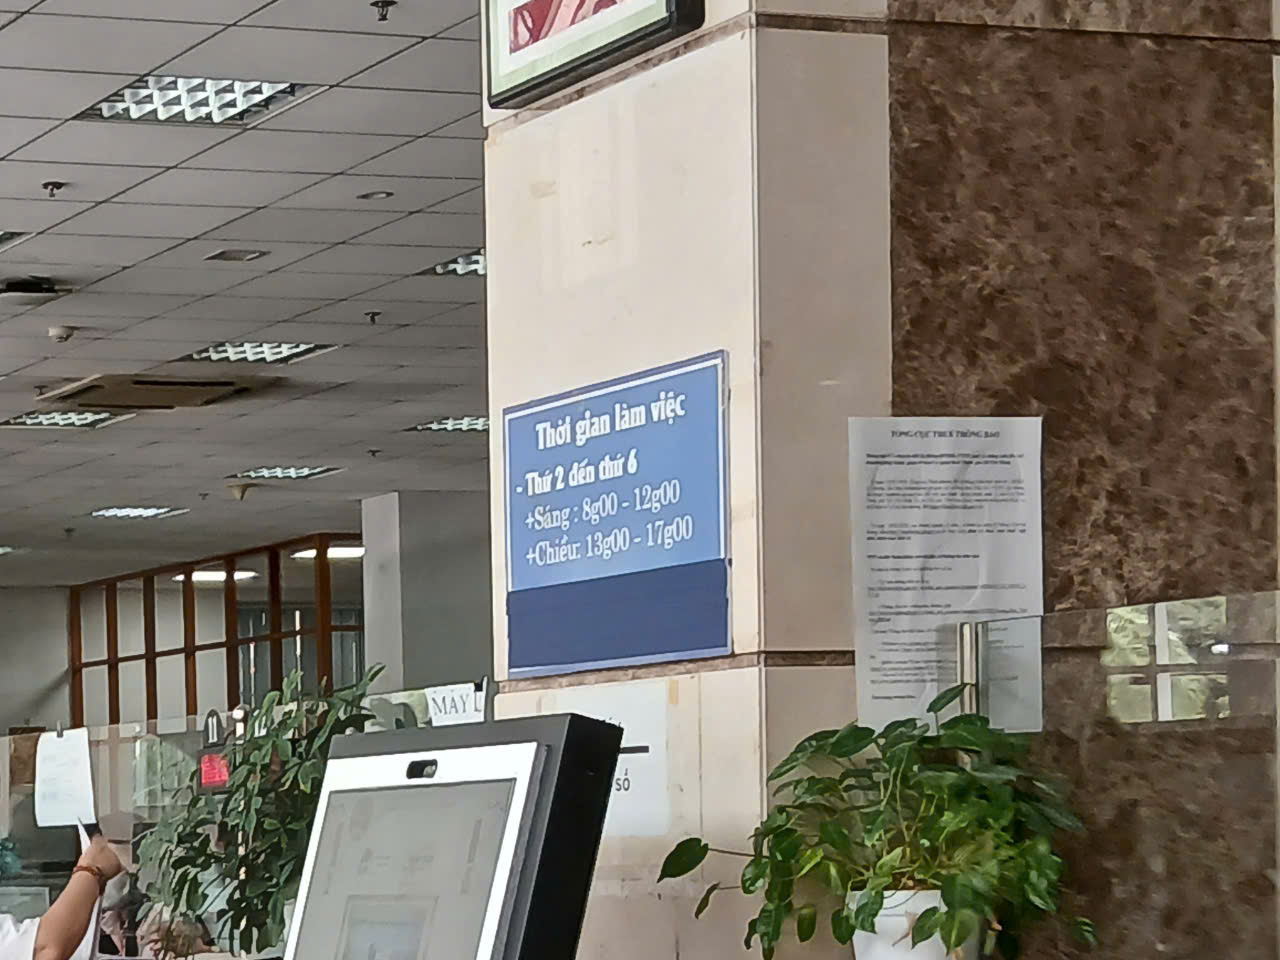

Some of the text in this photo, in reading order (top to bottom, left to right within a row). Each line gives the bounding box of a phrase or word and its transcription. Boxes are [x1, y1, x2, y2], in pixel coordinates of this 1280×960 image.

[534, 390, 687, 450] Thời gian làm việc
[525, 469, 554, 497] Thứ
[554, 465, 566, 491] 2
[569, 457, 596, 487] đến
[598, 453, 625, 481] thứ
[627, 447, 639, 475] 6
[581, 491, 619, 525] 8g00
[633, 479, 681, 513] 12g00
[585, 526, 631, 560] 13g00
[646, 514, 694, 550] 17g00
